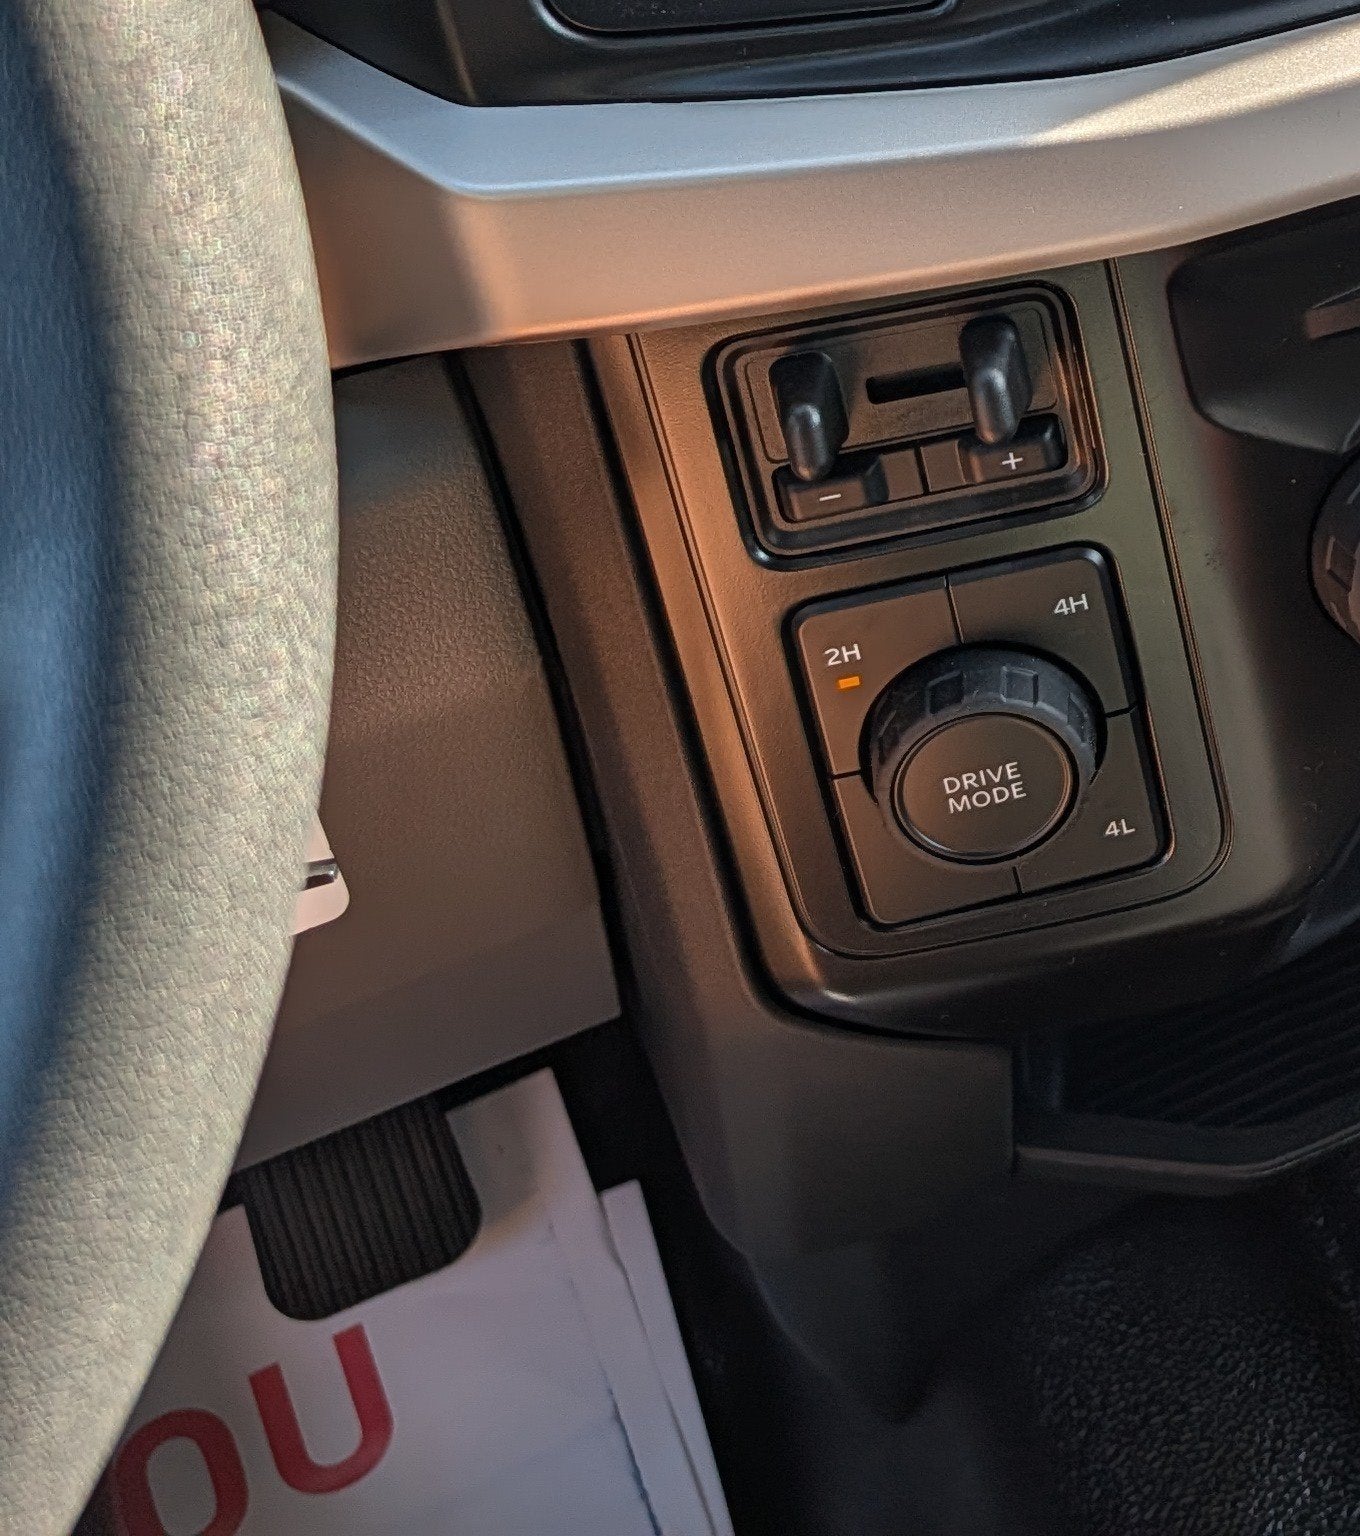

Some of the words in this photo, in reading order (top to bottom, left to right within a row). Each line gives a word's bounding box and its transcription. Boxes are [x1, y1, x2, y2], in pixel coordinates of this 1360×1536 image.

[1053, 593, 1089, 616] 4H
[824, 643, 861, 666] 2H
[943, 762, 1021, 794] DRIVE
[948, 781, 1027, 814] MODE
[1104, 818, 1136, 838] 4L
